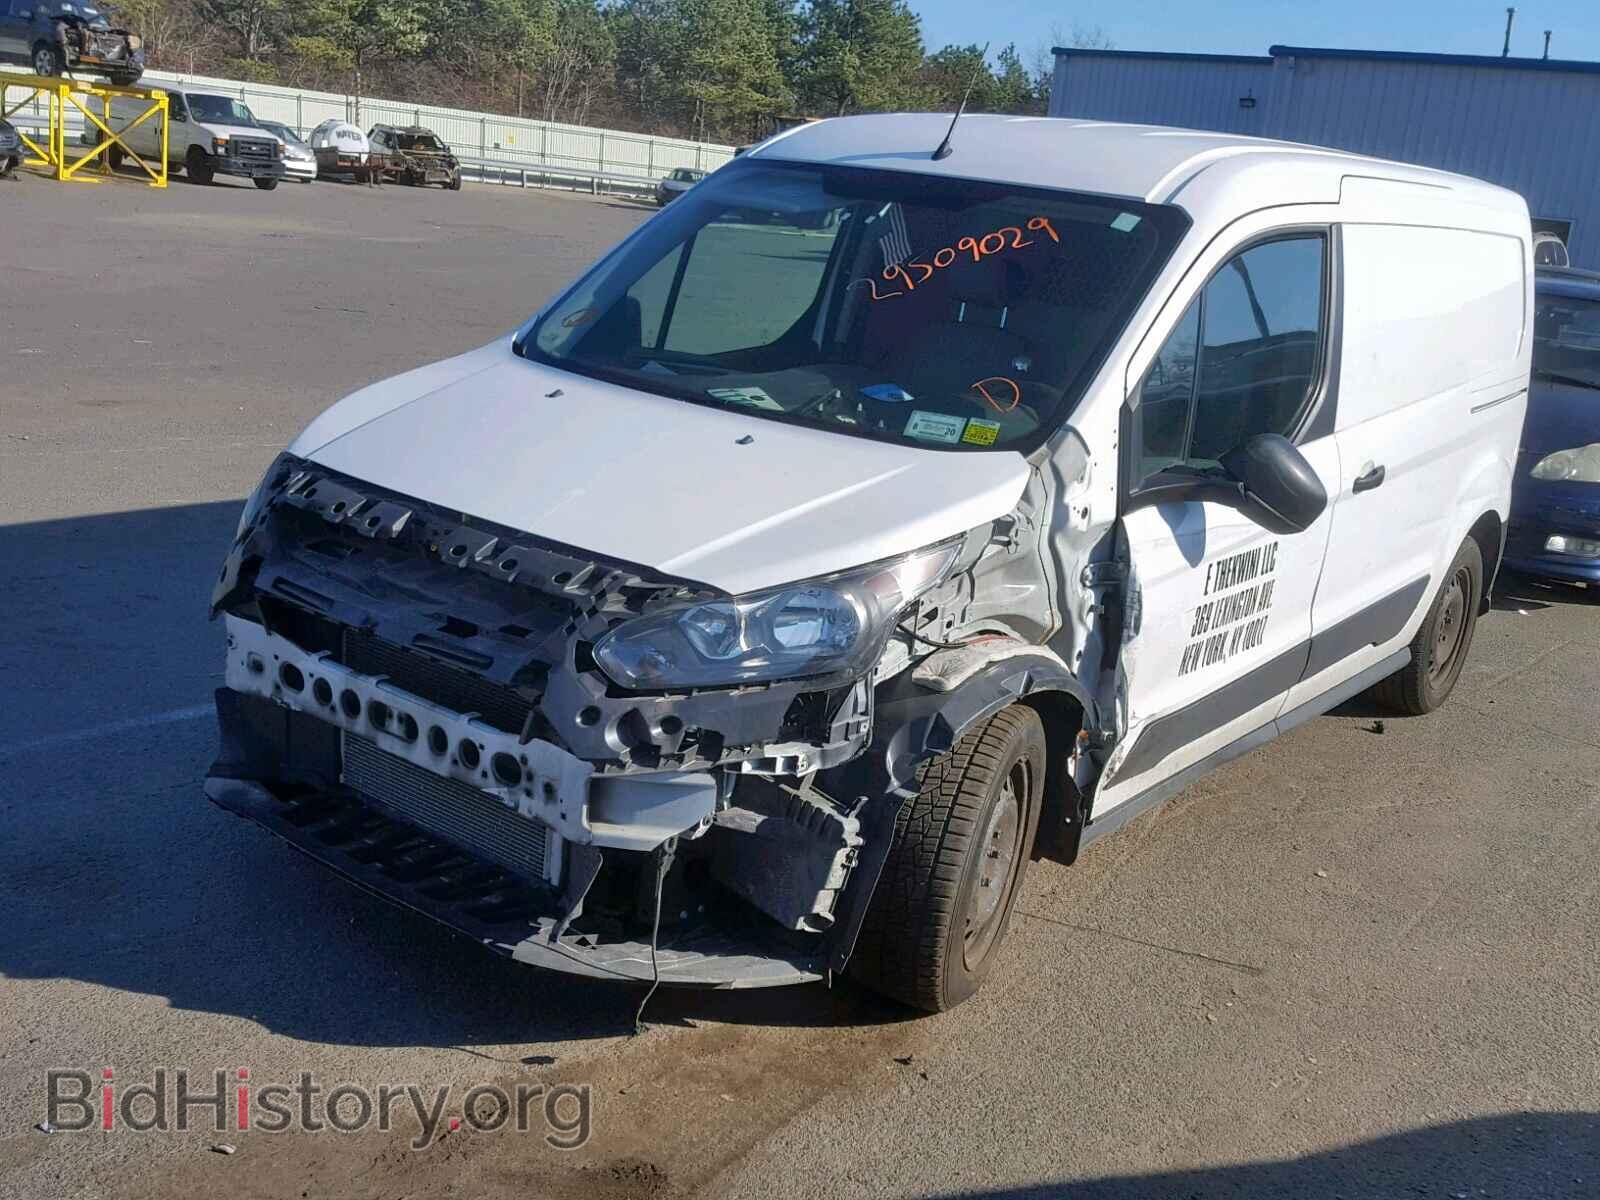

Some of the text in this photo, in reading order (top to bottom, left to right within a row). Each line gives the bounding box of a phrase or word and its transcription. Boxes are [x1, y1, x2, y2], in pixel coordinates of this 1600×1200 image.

[336, 130, 362, 142] WATER
[847, 217, 1060, 300] 29509029
[972, 377, 1021, 414] D
[1204, 541, 1278, 596] E THEKWINI LLC
[1191, 602, 1214, 638] 369
[1211, 585, 1260, 630] LEXINGTON
[1178, 640, 1204, 677] NEW
[1229, 624, 1245, 657] NY
[1242, 615, 1268, 652] 10017
